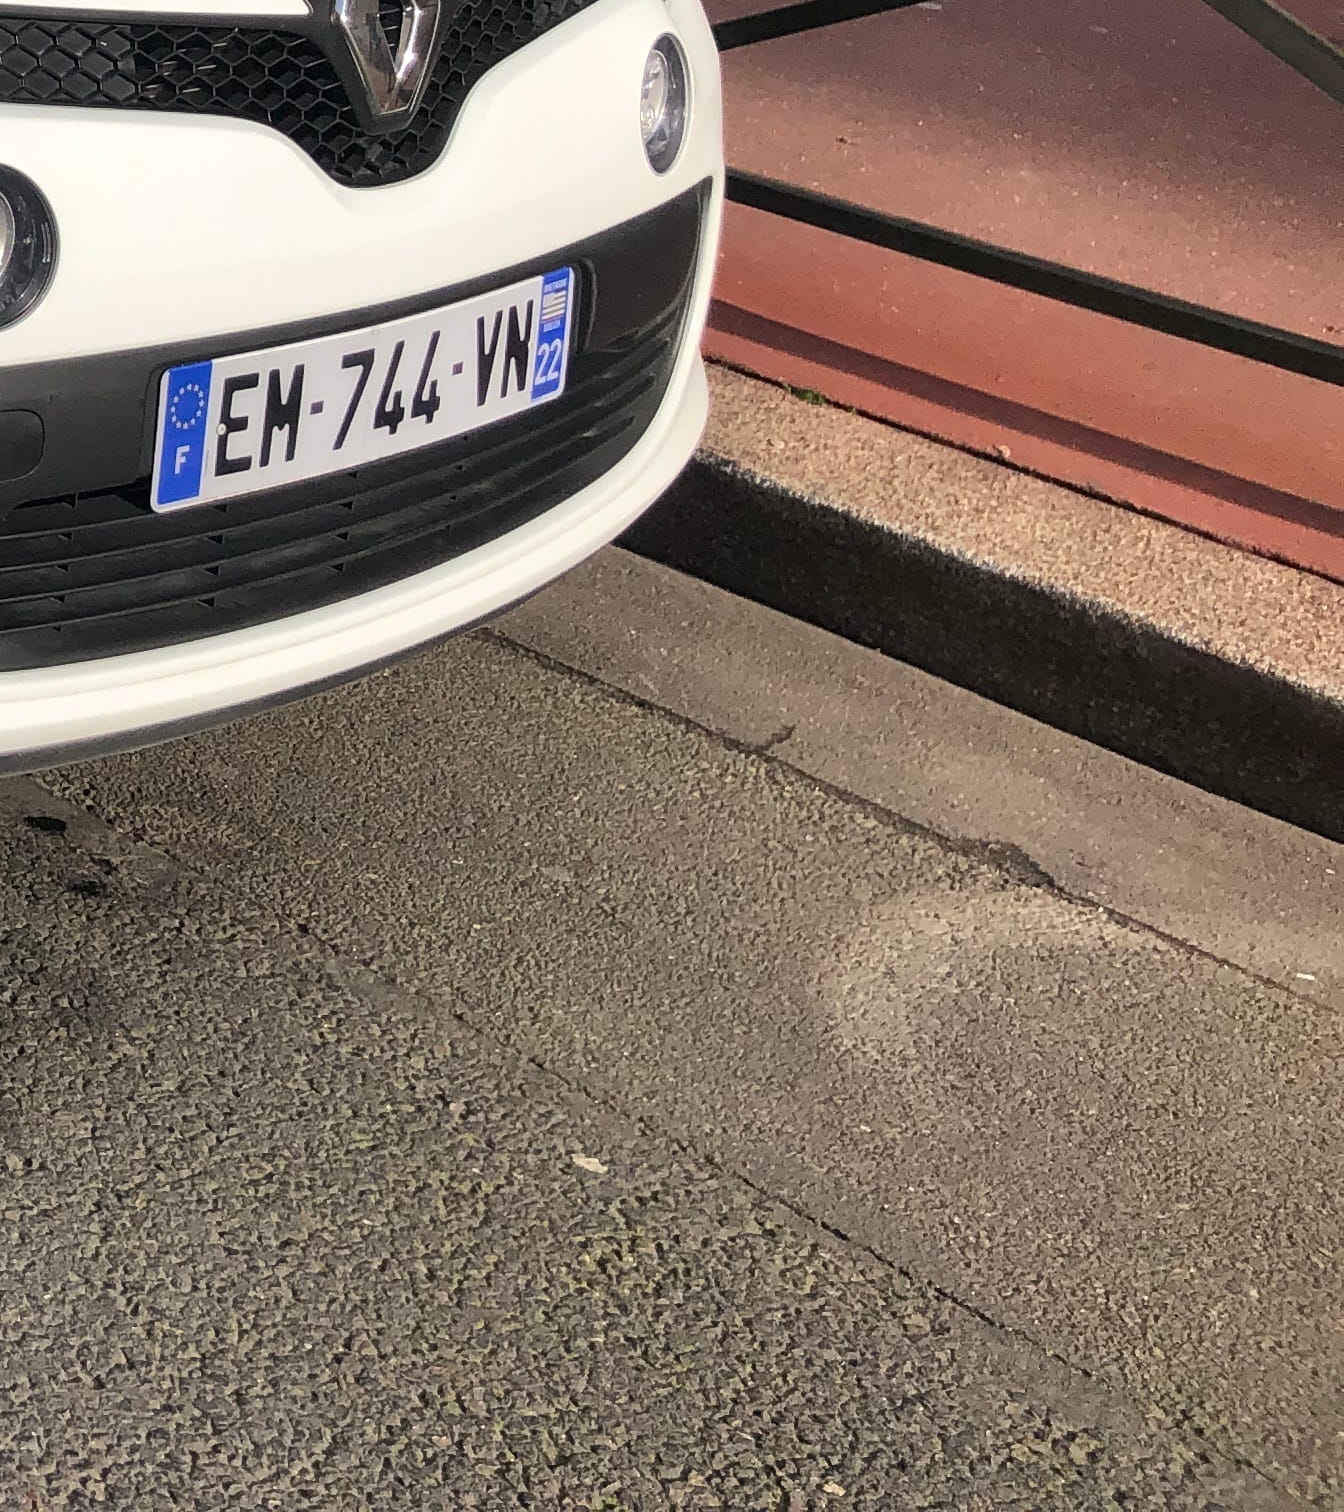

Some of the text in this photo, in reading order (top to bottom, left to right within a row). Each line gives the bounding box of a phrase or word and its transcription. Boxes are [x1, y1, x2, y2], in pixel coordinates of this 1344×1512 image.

[534, 338, 562, 386] 22
[214, 299, 534, 476] EM-744-VN
[174, 444, 191, 475] F
